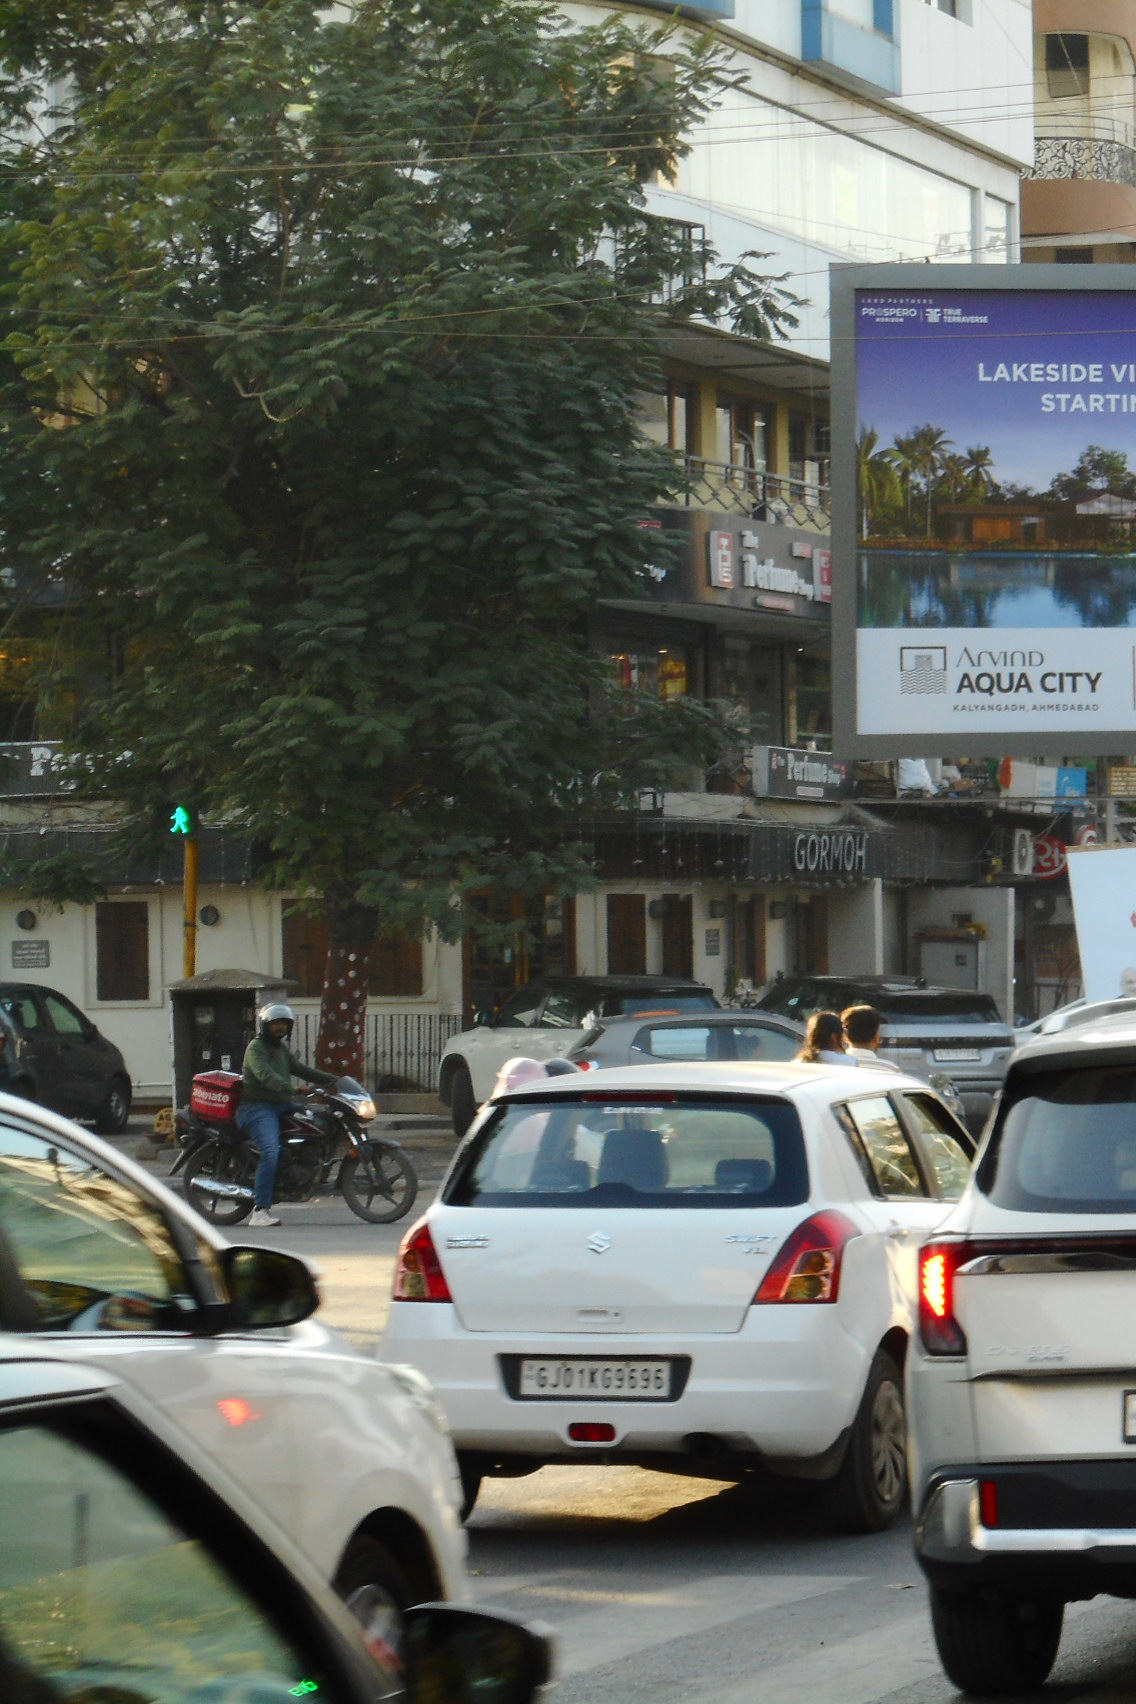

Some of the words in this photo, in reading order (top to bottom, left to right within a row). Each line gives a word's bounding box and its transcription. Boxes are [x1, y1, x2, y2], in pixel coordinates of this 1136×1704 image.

[862, 307, 917, 317] PROSPERO
[943, 308, 961, 316] TRUE
[977, 363, 1104, 383] LAKESIDE
[743, 553, 799, 594] Perfume
[956, 672, 1033, 697] AQUA
[1040, 672, 1103, 693] CITY
[952, 704, 1029, 712] KALYANGADH,
[1031, 703, 1099, 712] AHMEDABAD
